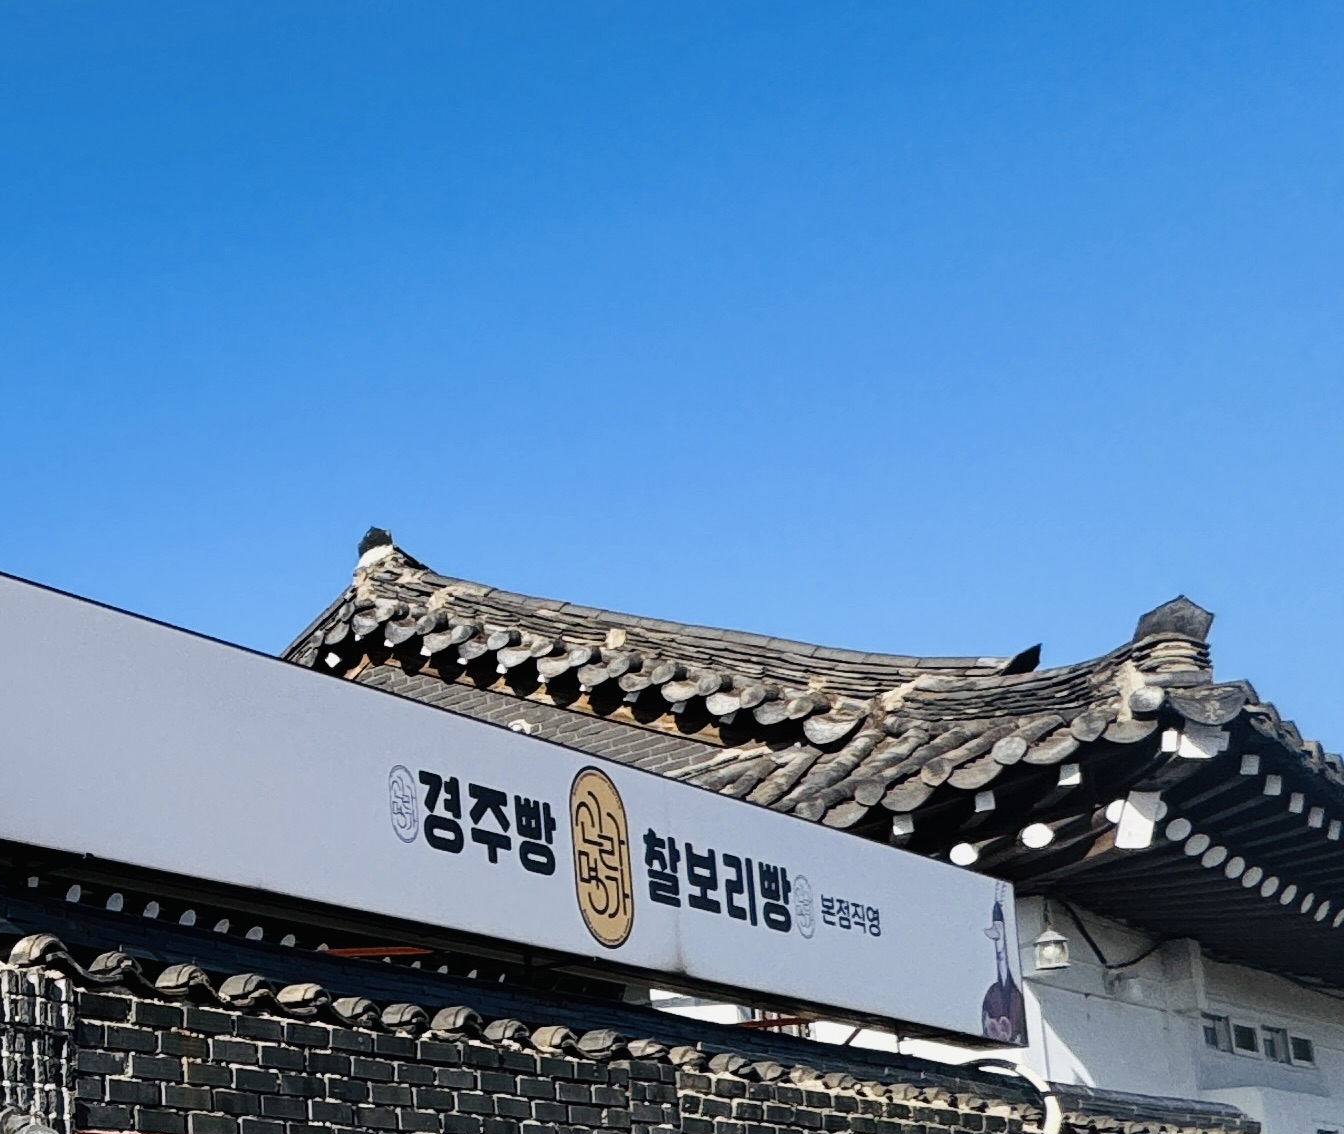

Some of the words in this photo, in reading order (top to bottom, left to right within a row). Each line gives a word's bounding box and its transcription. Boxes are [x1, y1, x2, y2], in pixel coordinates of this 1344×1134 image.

[418, 770, 557, 876] 경주빵
[643, 828, 792, 933] 찰보리빵
[820, 894, 881, 937] 본점직영
